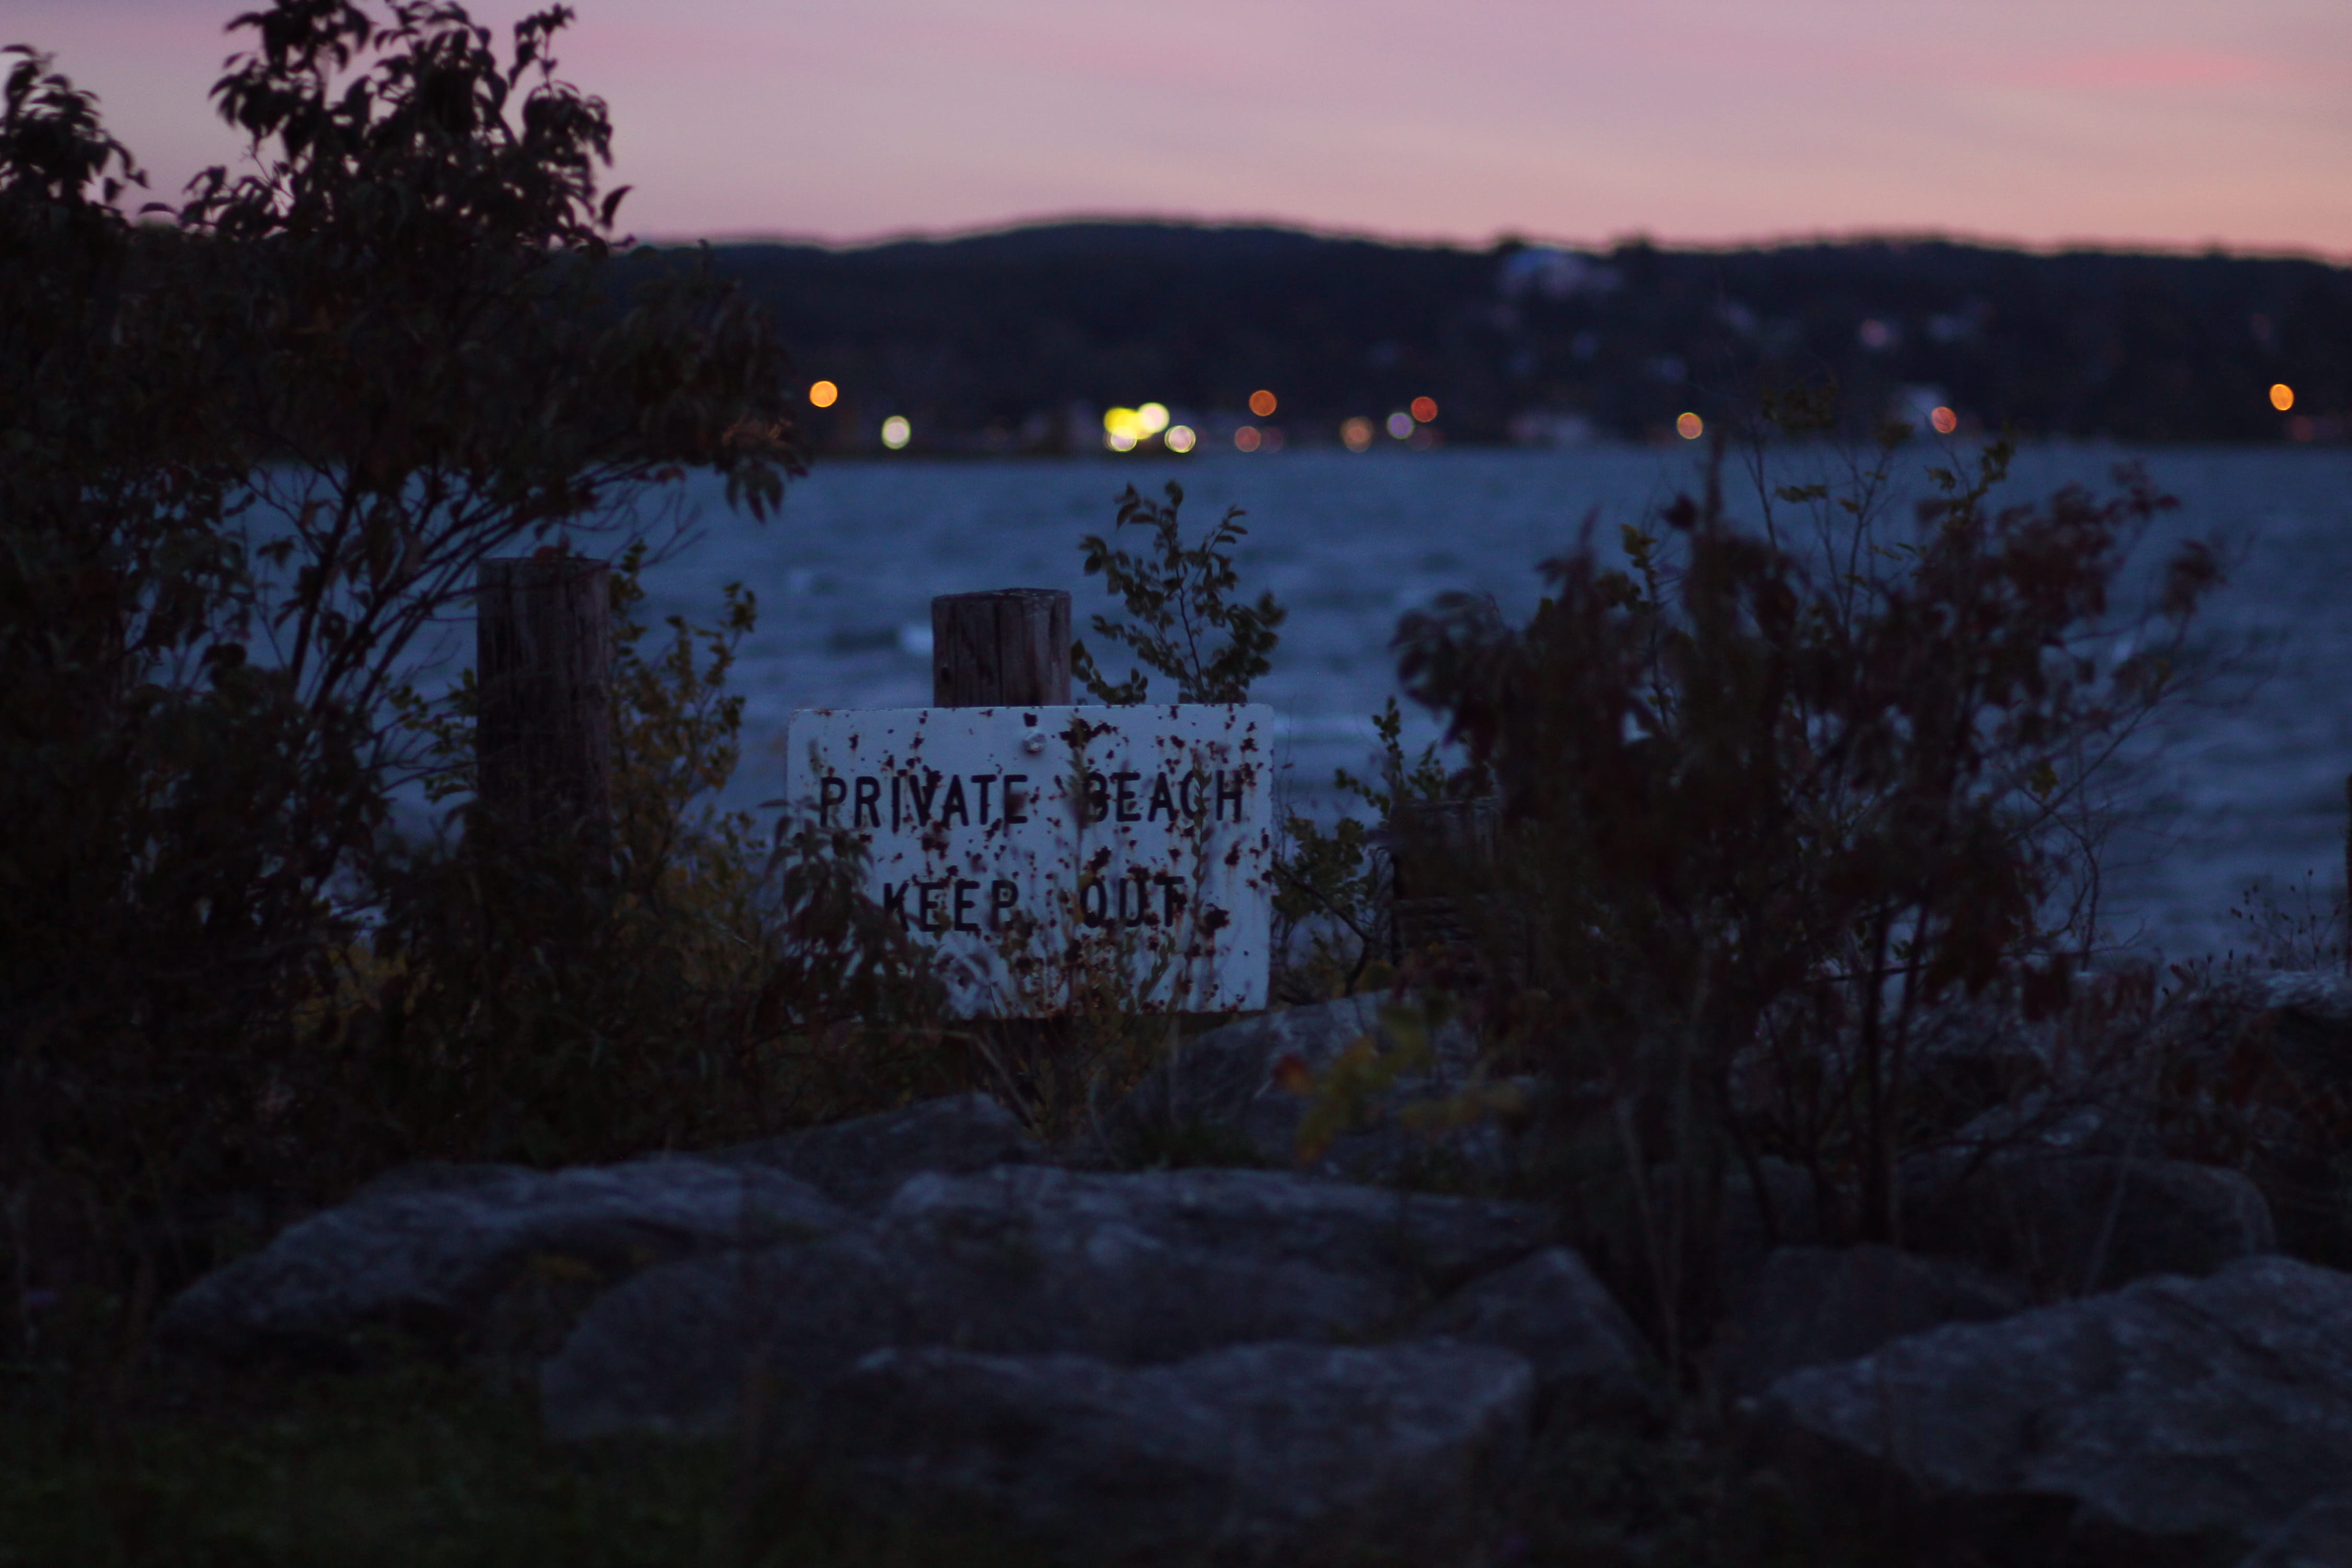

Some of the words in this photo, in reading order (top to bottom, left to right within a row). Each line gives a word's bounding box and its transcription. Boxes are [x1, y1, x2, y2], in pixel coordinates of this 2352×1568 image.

[820, 775, 1028, 828] PRIVATE
[1080, 771, 1242, 823] BEACH
[884, 880, 1018, 932] KEEP
[1079, 876, 1185, 929] OUT
